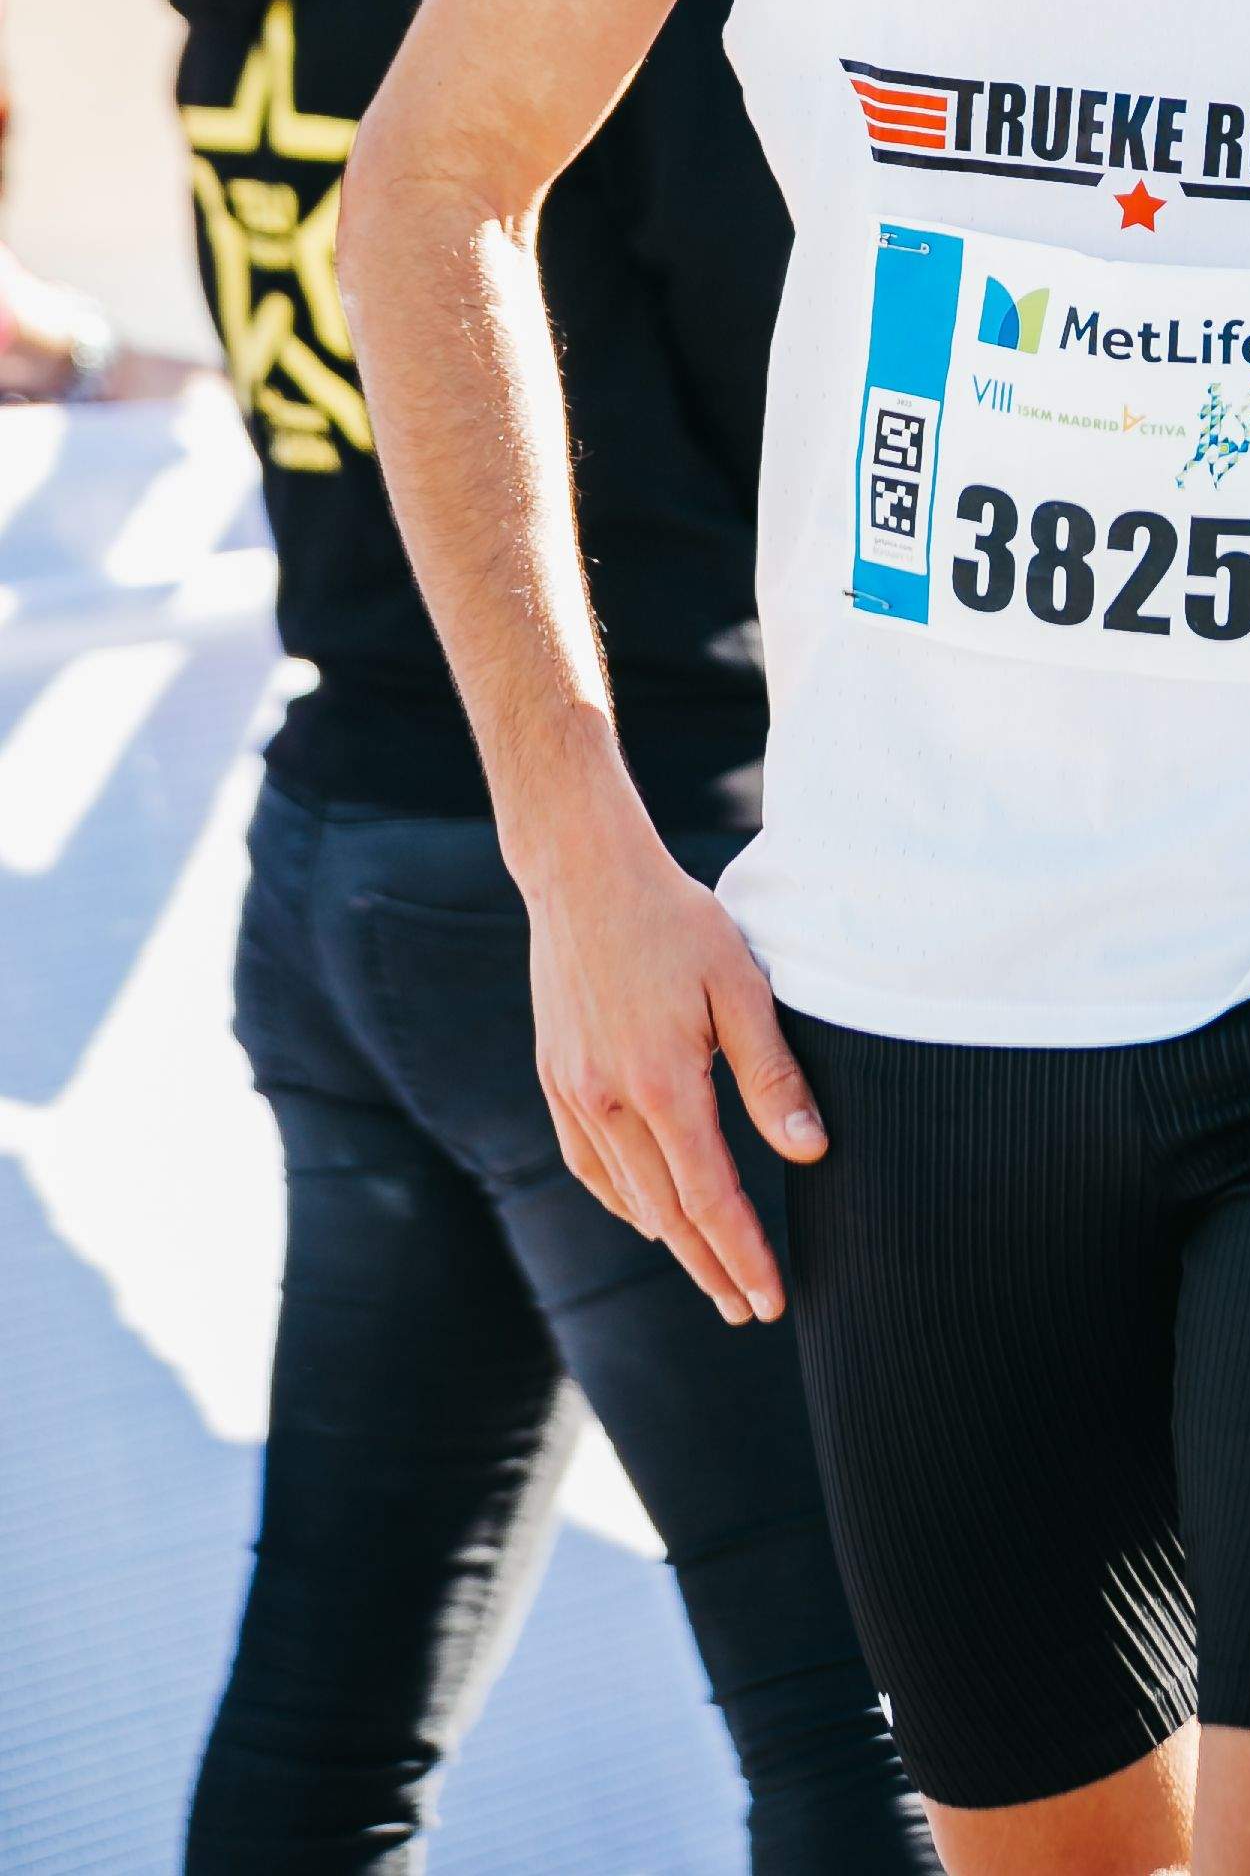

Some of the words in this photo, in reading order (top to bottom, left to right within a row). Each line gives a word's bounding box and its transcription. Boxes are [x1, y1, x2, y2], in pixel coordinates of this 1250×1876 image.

[950, 79, 1187, 174] TRUEKE
[972, 374, 1014, 413] VIII
[1057, 411, 1119, 433] MADRID
